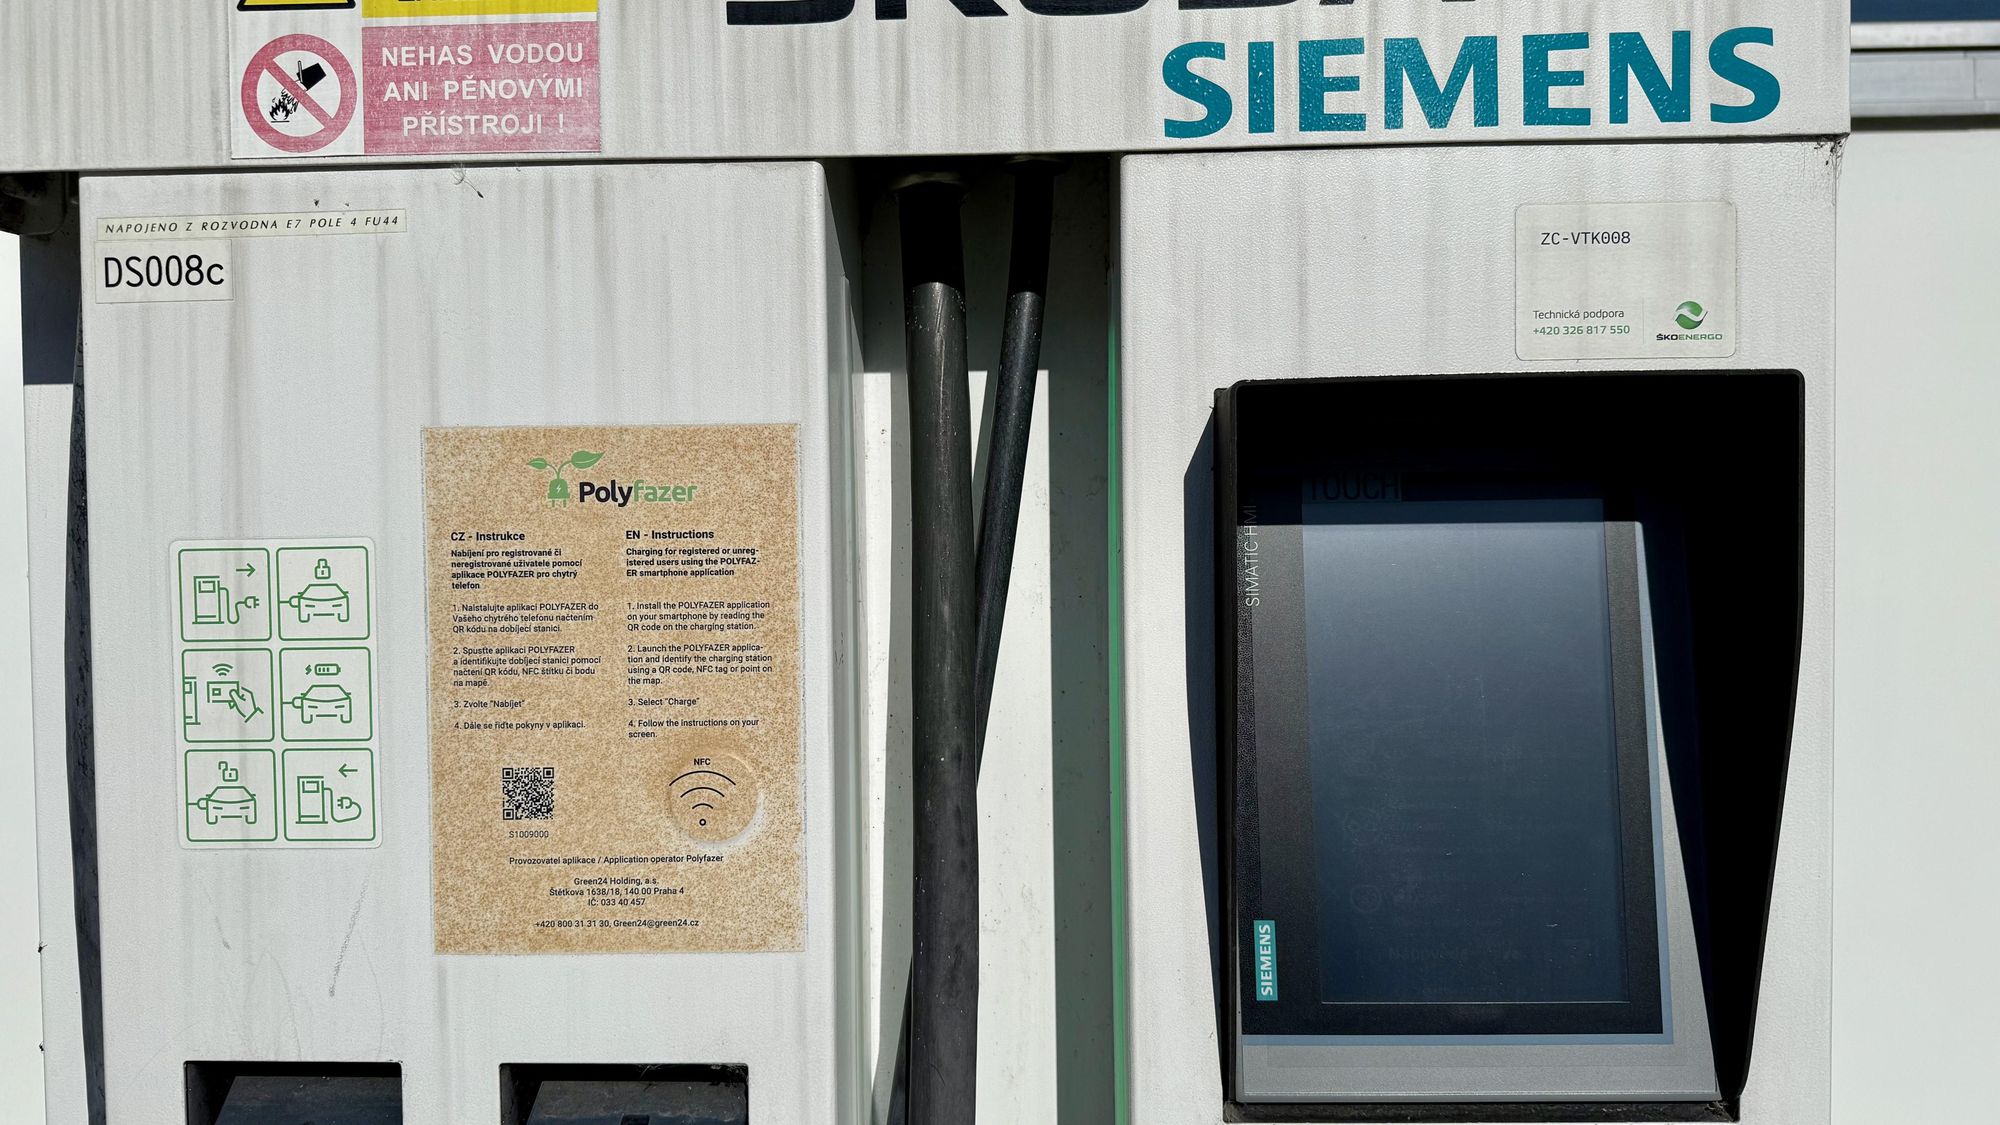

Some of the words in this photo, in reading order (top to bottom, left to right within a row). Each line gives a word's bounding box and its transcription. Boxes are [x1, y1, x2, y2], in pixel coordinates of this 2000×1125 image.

[382, 45, 472, 67] NEHAS
[488, 42, 583, 64] VODOU
[384, 81, 428, 101] ANI
[444, 73, 583, 100] PĚNOVÝMI
[1162, 26, 1781, 139] SIEMENS
[403, 111, 542, 136] PŘÍSTROJI
[558, 114, 564, 134] !
[105, 222, 178, 234] NAPOJENO
[185, 222, 193, 232] Z
[201, 219, 278, 231] ROZVODNA
[286, 219, 302, 229] E7
[309, 217, 342, 228] POLE
[350, 217, 357, 226] 4
[365, 216, 399, 226] FU44
[1541, 231, 1631, 245] ZC-VTK008
[104, 254, 225, 288] DS008c
[1533, 310, 1580, 319] Technická
[1583, 309, 1624, 320] podpora
[1533, 326, 1560, 335] +420
[1563, 326, 1583, 334] 326
[1587, 326, 1606, 334] 817
[1610, 325, 1630, 334] 550
[1656, 333, 1723, 341] ŠKOENERGO
[579, 479, 698, 507] Polyfazer
[1243, 506, 1257, 536] HMI
[450, 532, 465, 541] CZ
[476, 531, 526, 541] Instrukce
[625, 530, 640, 539] EN
[651, 529, 715, 539] Instructions
[451, 549, 484, 559] Nabíjení
[486, 551, 500, 559] pro
[501, 548, 552, 558] registrované
[554, 548, 562, 556] či
[626, 548, 663, 557] Charging
[678, 547, 720, 557] registered
[732, 548, 759, 556] unreg-
[451, 559, 511, 570] neregistrované
[513, 559, 550, 567] uživatele
[552, 558, 583, 568] pomocí
[626, 558, 655, 566] istered
[681, 558, 703, 567] using
[451, 571, 485, 580] aplikace
[487, 570, 535, 578] POLYFAZER
[536, 571, 550, 579] pro
[552, 569, 578, 579] chytrý
[626, 569, 638, 577] ER
[639, 568, 688, 578] smartphone
[690, 568, 735, 578] application
[1244, 541, 1260, 607] SIMATIC
[452, 581, 480, 589] telefon
[506, 603, 538, 613] aplikaci
[539, 603, 587, 611] POLYFAZER
[588, 602, 599, 610] do
[678, 601, 725, 609] POLYFAZER
[727, 601, 770, 610] application
[452, 614, 482, 622] Vašeho
[484, 614, 519, 624] chytrého
[555, 613, 594, 621] načtením
[639, 614, 657, 622] your
[659, 612, 707, 622] smartphone
[709, 612, 719, 621] by
[720, 612, 750, 621] reading
[752, 611, 765, 619] the
[452, 626, 464, 634] QR
[466, 625, 486, 633] kódu
[499, 624, 532, 634] dobíjecí
[533, 624, 562, 632] stanici.
[627, 623, 639, 632] QR
[641, 623, 661, 631] code
[690, 622, 725, 632] charging
[726, 622, 756, 630] station.
[463, 646, 493, 656] Spusťte
[495, 646, 526, 656] aplikaci
[683, 644, 730, 652] POLYFAZER
[731, 644, 763, 653] applica-
[460, 657, 507, 667] identifikujte
[508, 656, 540, 666] dobíjecí
[542, 656, 569, 664] stanici
[570, 655, 601, 666] pomocí
[627, 655, 643, 663] tion
[645, 655, 660, 663] and
[662, 655, 692, 664] identify
[708, 654, 743, 664] charging
[745, 654, 773, 662] station
[484, 668, 496, 676] QR
[498, 667, 520, 676] kódu,
[627, 666, 650, 676] using
[659, 666, 671, 674] QR
[672, 666, 695, 675] code,
[715, 666, 728, 675] tag
[740, 665, 761, 674] point
[642, 678, 663, 686] map.
[463, 700, 488, 708] Zvolte
[638, 698, 663, 706] Select
[464, 721, 481, 729] Dále
[515, 721, 544, 730] pokyny
[552, 720, 586, 730] aplikaci.
[638, 719, 664, 727] Follow
[666, 719, 679, 727] the
[681, 719, 728, 727] instructions
[741, 720, 759, 728] your
[509, 856, 561, 865] Provozovatel
[562, 856, 596, 866] aplikace
[603, 855, 649, 866] Application
[651, 855, 684, 865] operator
[686, 854, 724, 865] Polyfazer
[574, 877, 608, 885] Green24
[609, 876, 643, 887] Holding,
[549, 886, 584, 896] Štětkova
[587, 887, 622, 897] 1638/18,
[624, 887, 639, 895] 140
[641, 887, 652, 895] 00
[653, 886, 677, 895] Praha
[588, 896, 599, 906] IČ:
[600, 898, 616, 906] 033
[618, 898, 628, 906] 40
[630, 898, 646, 906] 457
[535, 920, 556, 928] +420
[557, 919, 573, 928] 800
[575, 919, 584, 927] 31
[587, 919, 597, 927] 31
[599, 919, 612, 928] 30,
[613, 918, 699, 929] Green24@green24.cz
[1259, 924, 1273, 995] SIEMENS
